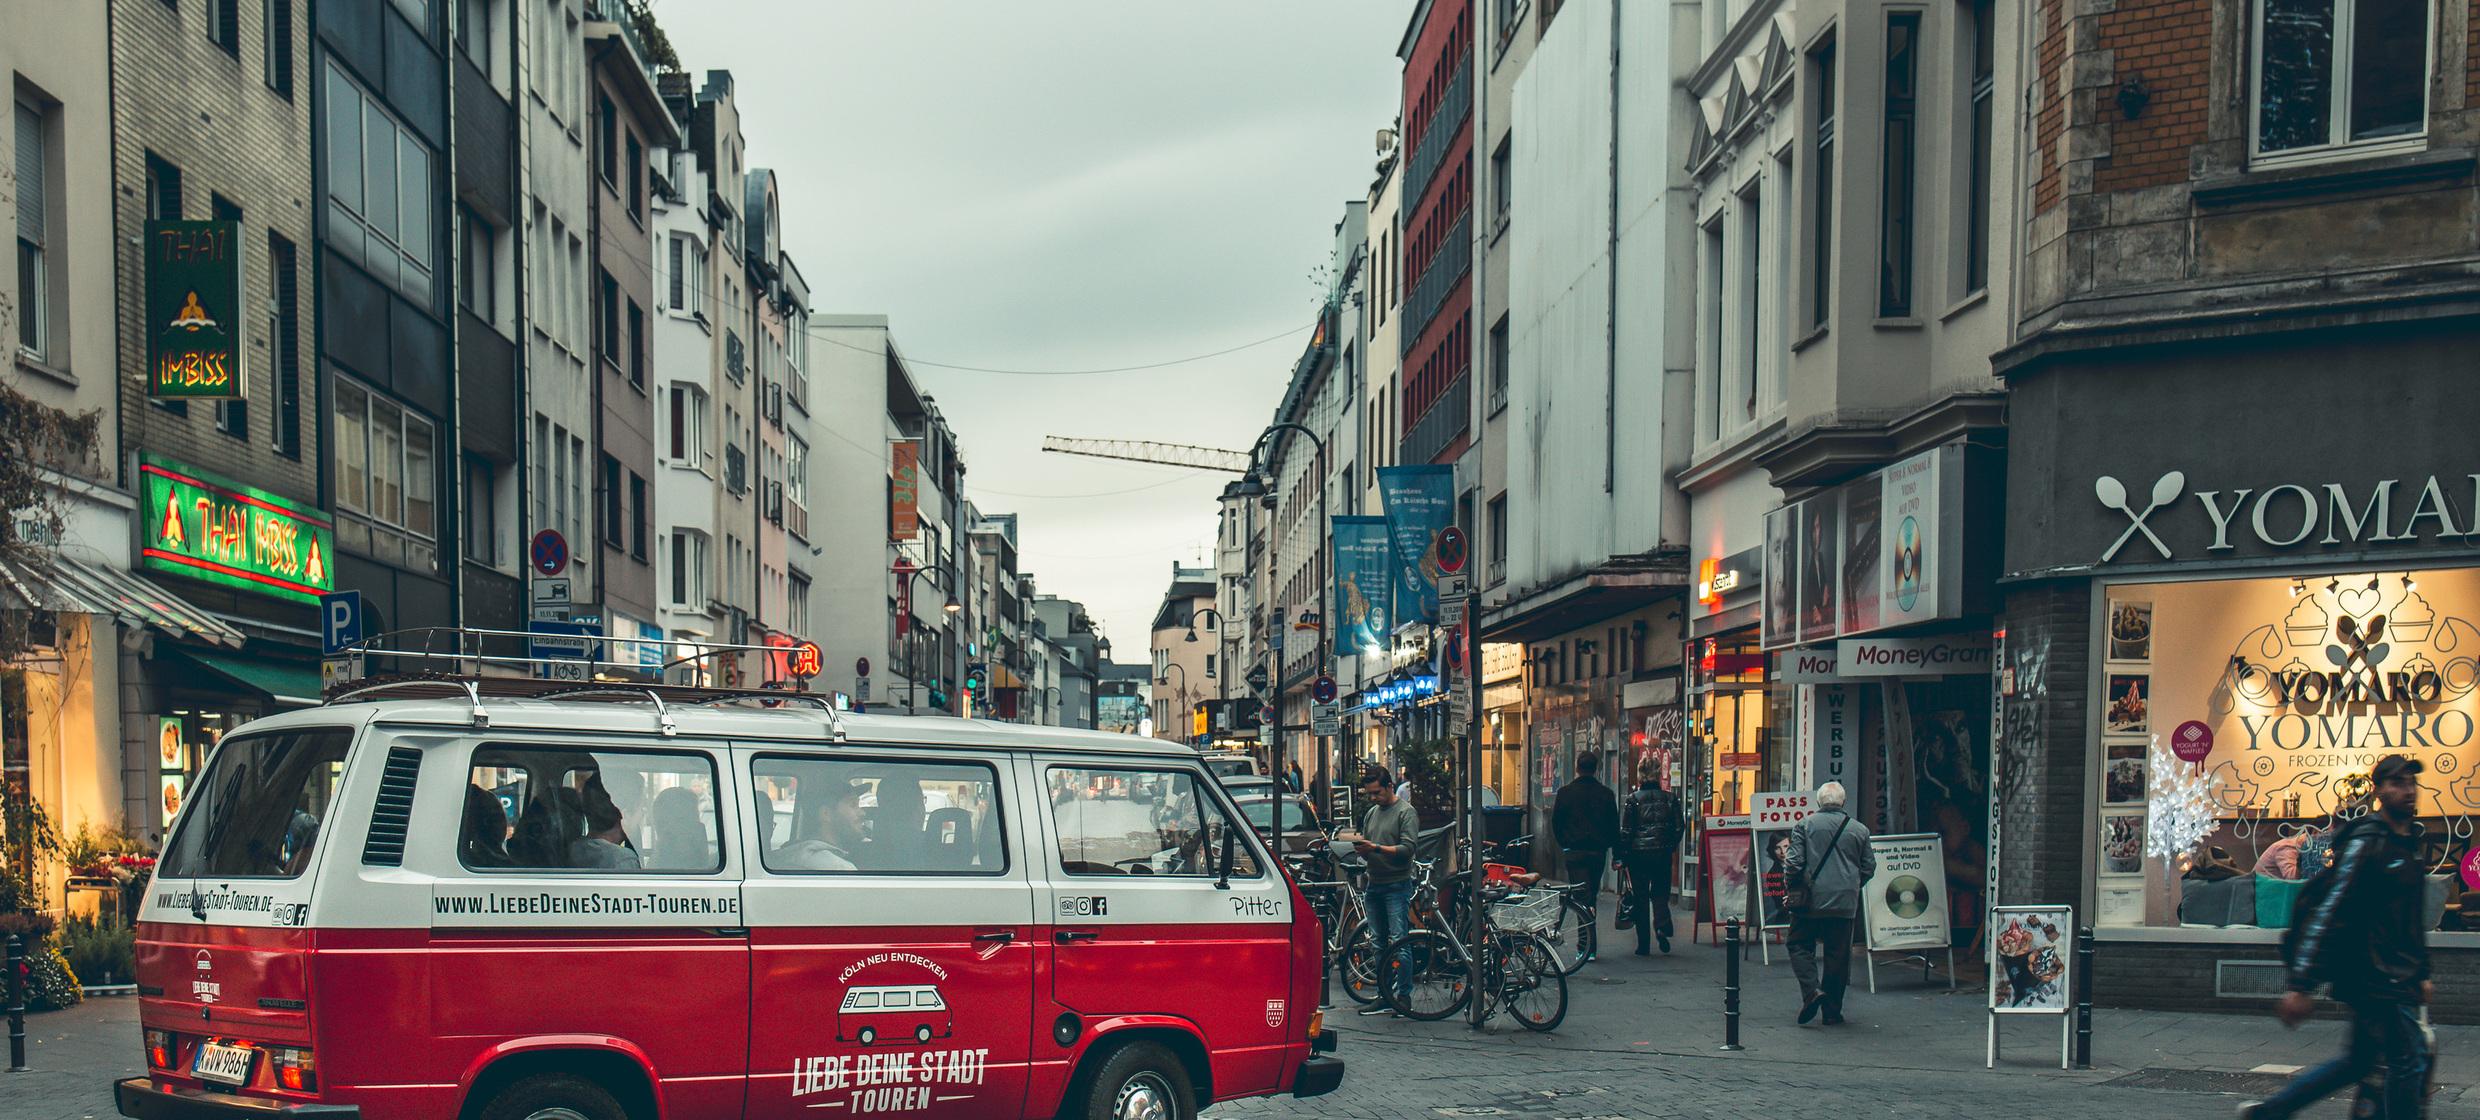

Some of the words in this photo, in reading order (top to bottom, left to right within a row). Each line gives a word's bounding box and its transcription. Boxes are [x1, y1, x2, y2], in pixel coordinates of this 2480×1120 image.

[160, 229, 225, 264] THAI
[161, 352, 227, 386] IMBISS
[196, 498, 247, 562] THAI
[255, 512, 298, 576] IMBISS
[331, 601, 352, 646] P
[2270, 671, 2442, 705] YOMARO
[2238, 709, 2474, 751] YOMARO
[2288, 754, 2348, 767] FROZEN
[1766, 797, 1807, 808] PASS
[1887, 862, 1901, 871] auf
[1903, 862, 1920, 870] DVD
[1229, 896, 1282, 916] Pitter
[838, 958, 866, 984] KÖLN
[867, 952, 888, 966] NEU
[890, 952, 948, 982] ENTDECKEN
[199, 1047, 209, 1070] K
[210, 1049, 225, 1072] VW
[222, 1050, 251, 1077] 986H
[792, 1055, 851, 1097] LIEBE
[856, 1052, 915, 1087] DEINE
[920, 1048, 989, 1085] STADT
[850, 1086, 931, 1114] TOUREN
